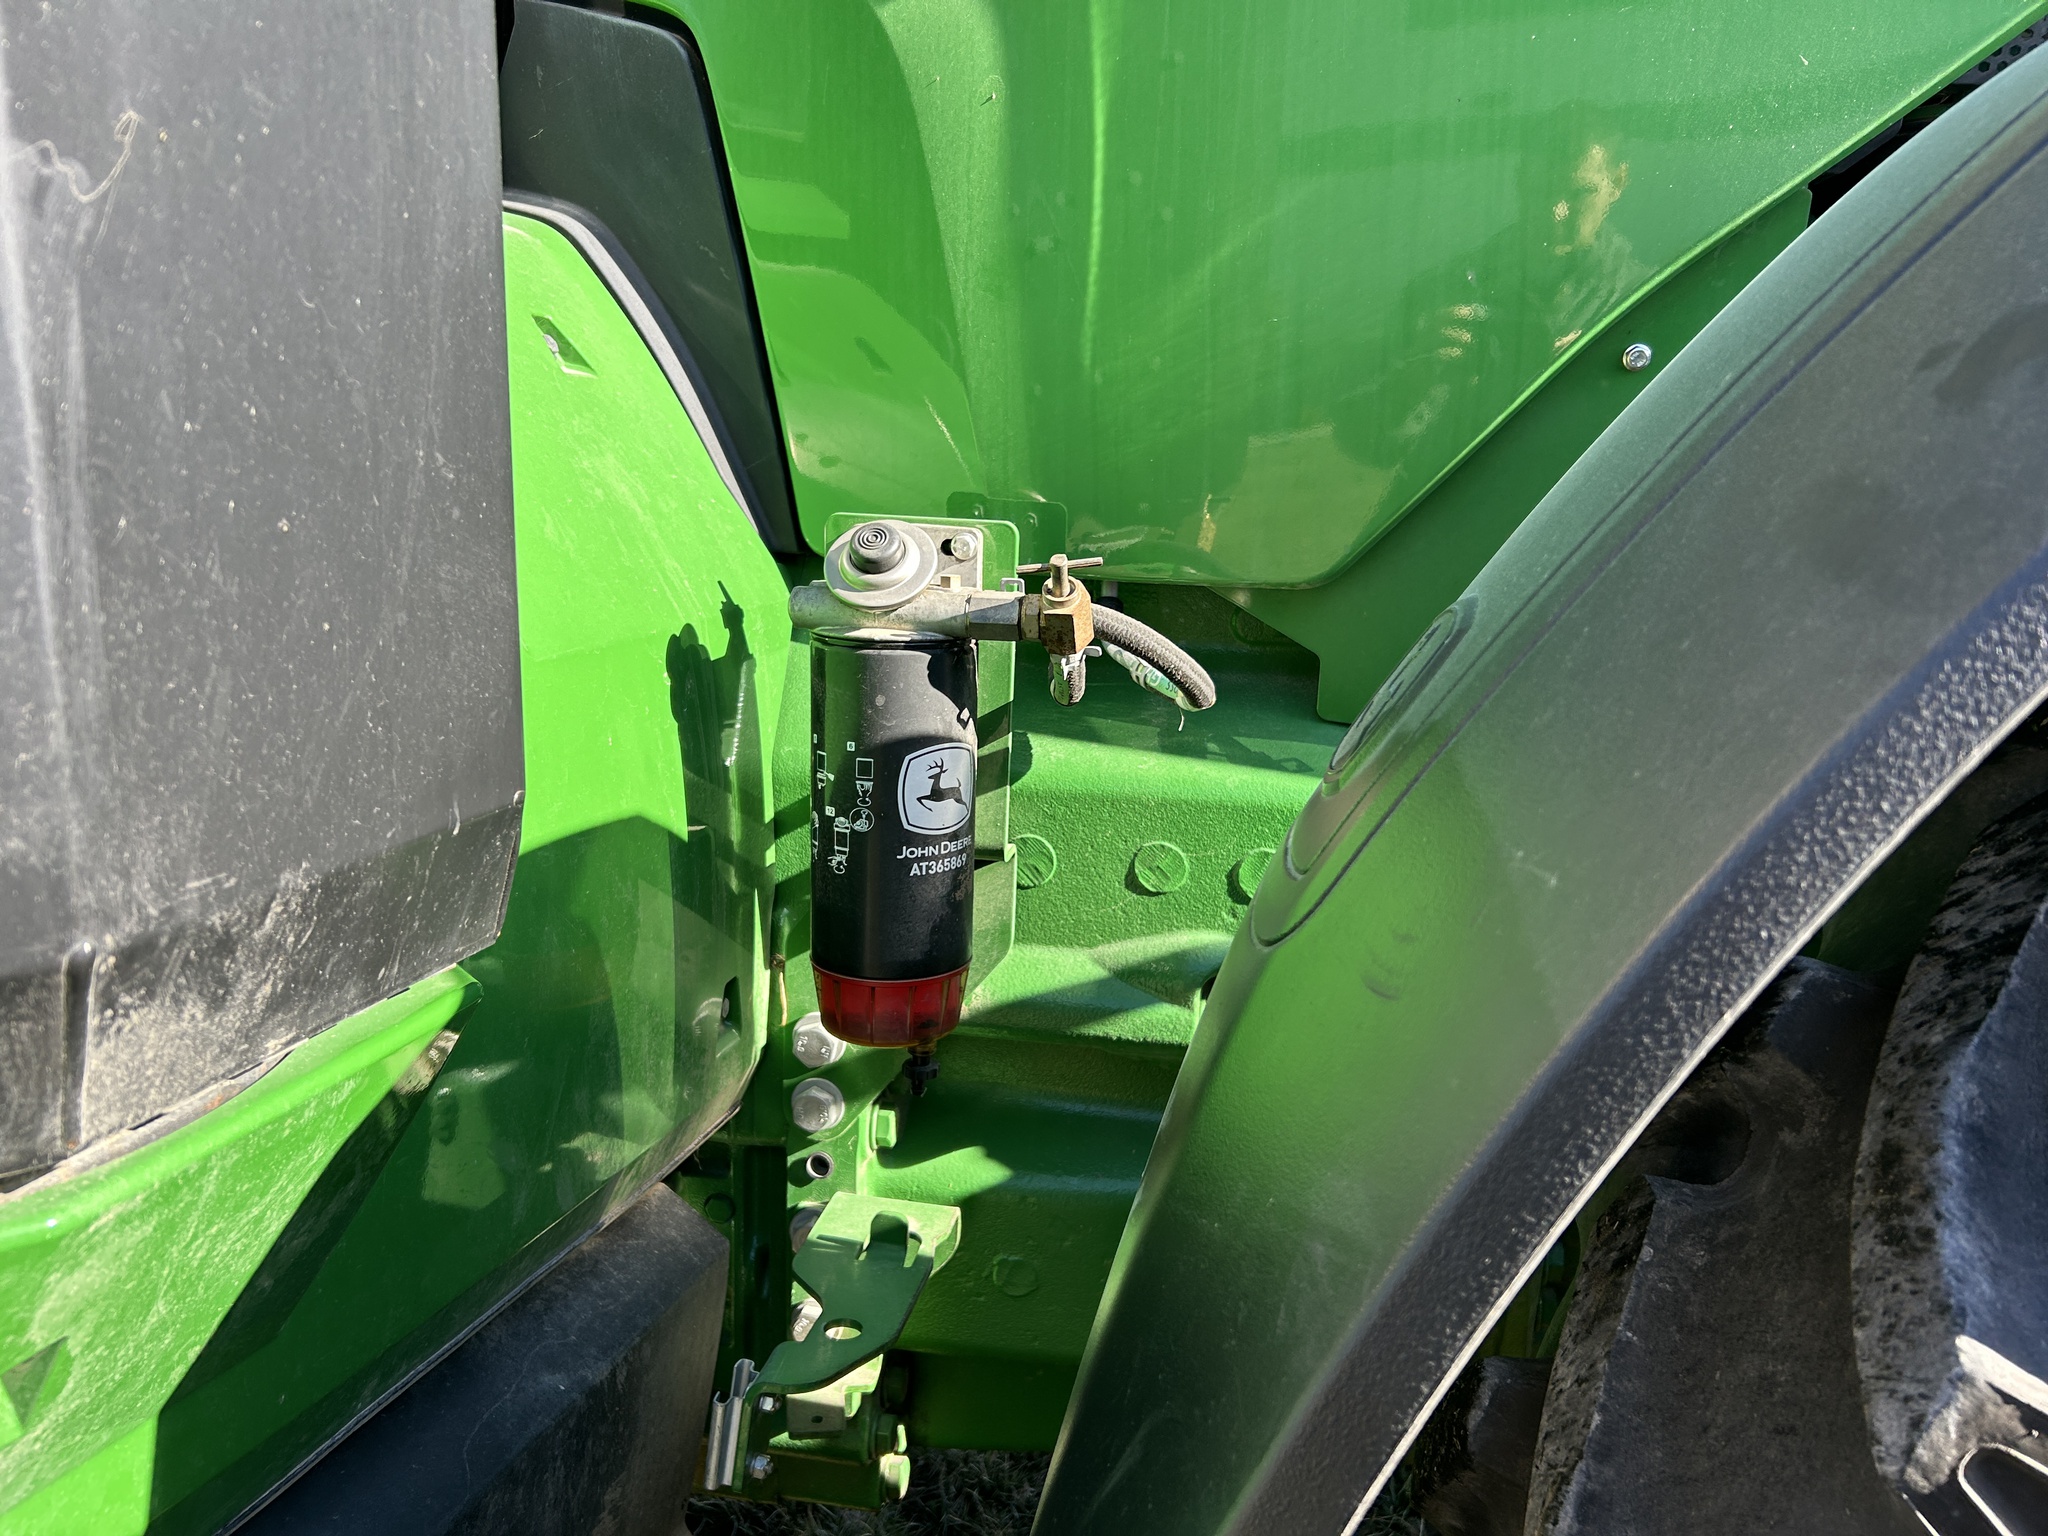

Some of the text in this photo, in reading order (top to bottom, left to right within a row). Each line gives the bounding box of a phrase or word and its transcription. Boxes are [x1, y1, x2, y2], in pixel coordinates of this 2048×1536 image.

[896, 835, 972, 859] JOHN DEERE
[909, 853, 967, 876] AT365869
